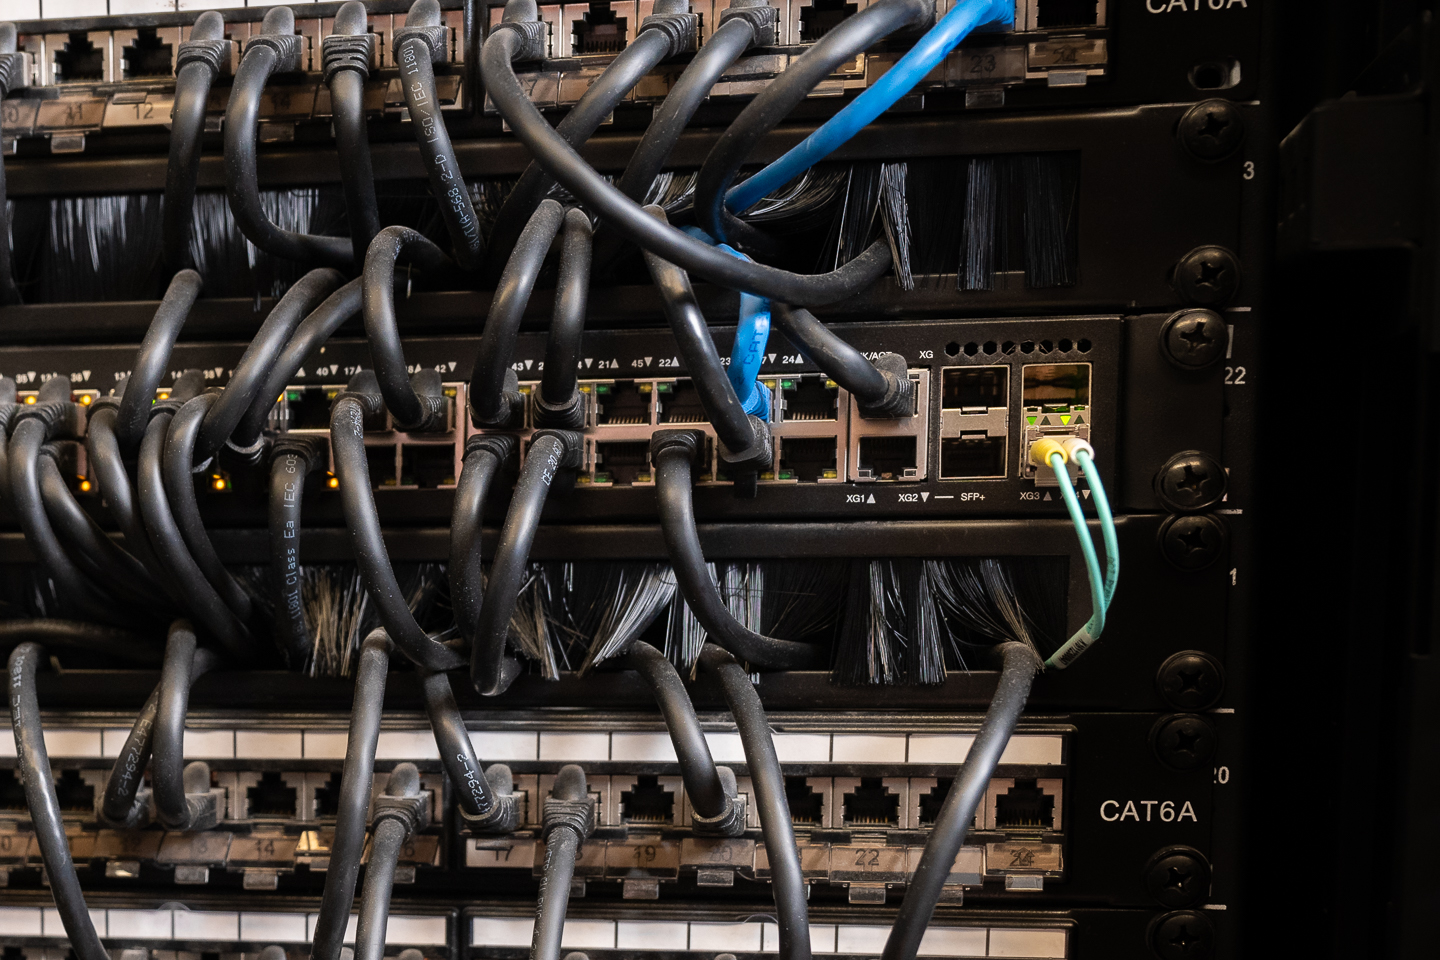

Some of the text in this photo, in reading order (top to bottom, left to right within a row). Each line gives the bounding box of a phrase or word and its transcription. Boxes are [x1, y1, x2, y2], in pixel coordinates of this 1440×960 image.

[403, 44, 439, 144] ISO/IEC 11801
[133, 102, 154, 119] 12
[782, 355, 796, 364] 24
[919, 350, 934, 359] XG
[511, 362, 524, 371] 43
[598, 360, 610, 370] 21
[631, 358, 644, 368] 45
[659, 358, 672, 367] 22
[317, 366, 329, 376] 40
[435, 364, 447, 373] 42
[1224, 366, 1247, 385] 22
[283, 482, 296, 508] IEC
[846, 494, 866, 504] XG1
[898, 493, 919, 503] XG2
[960, 492, 985, 502] SFP+
[1019, 491, 1040, 501] XG3
[283, 520, 296, 539] Ea
[286, 548, 298, 586] Class
[1099, 800, 1198, 823] CAT6A
[854, 849, 879, 866] 22
